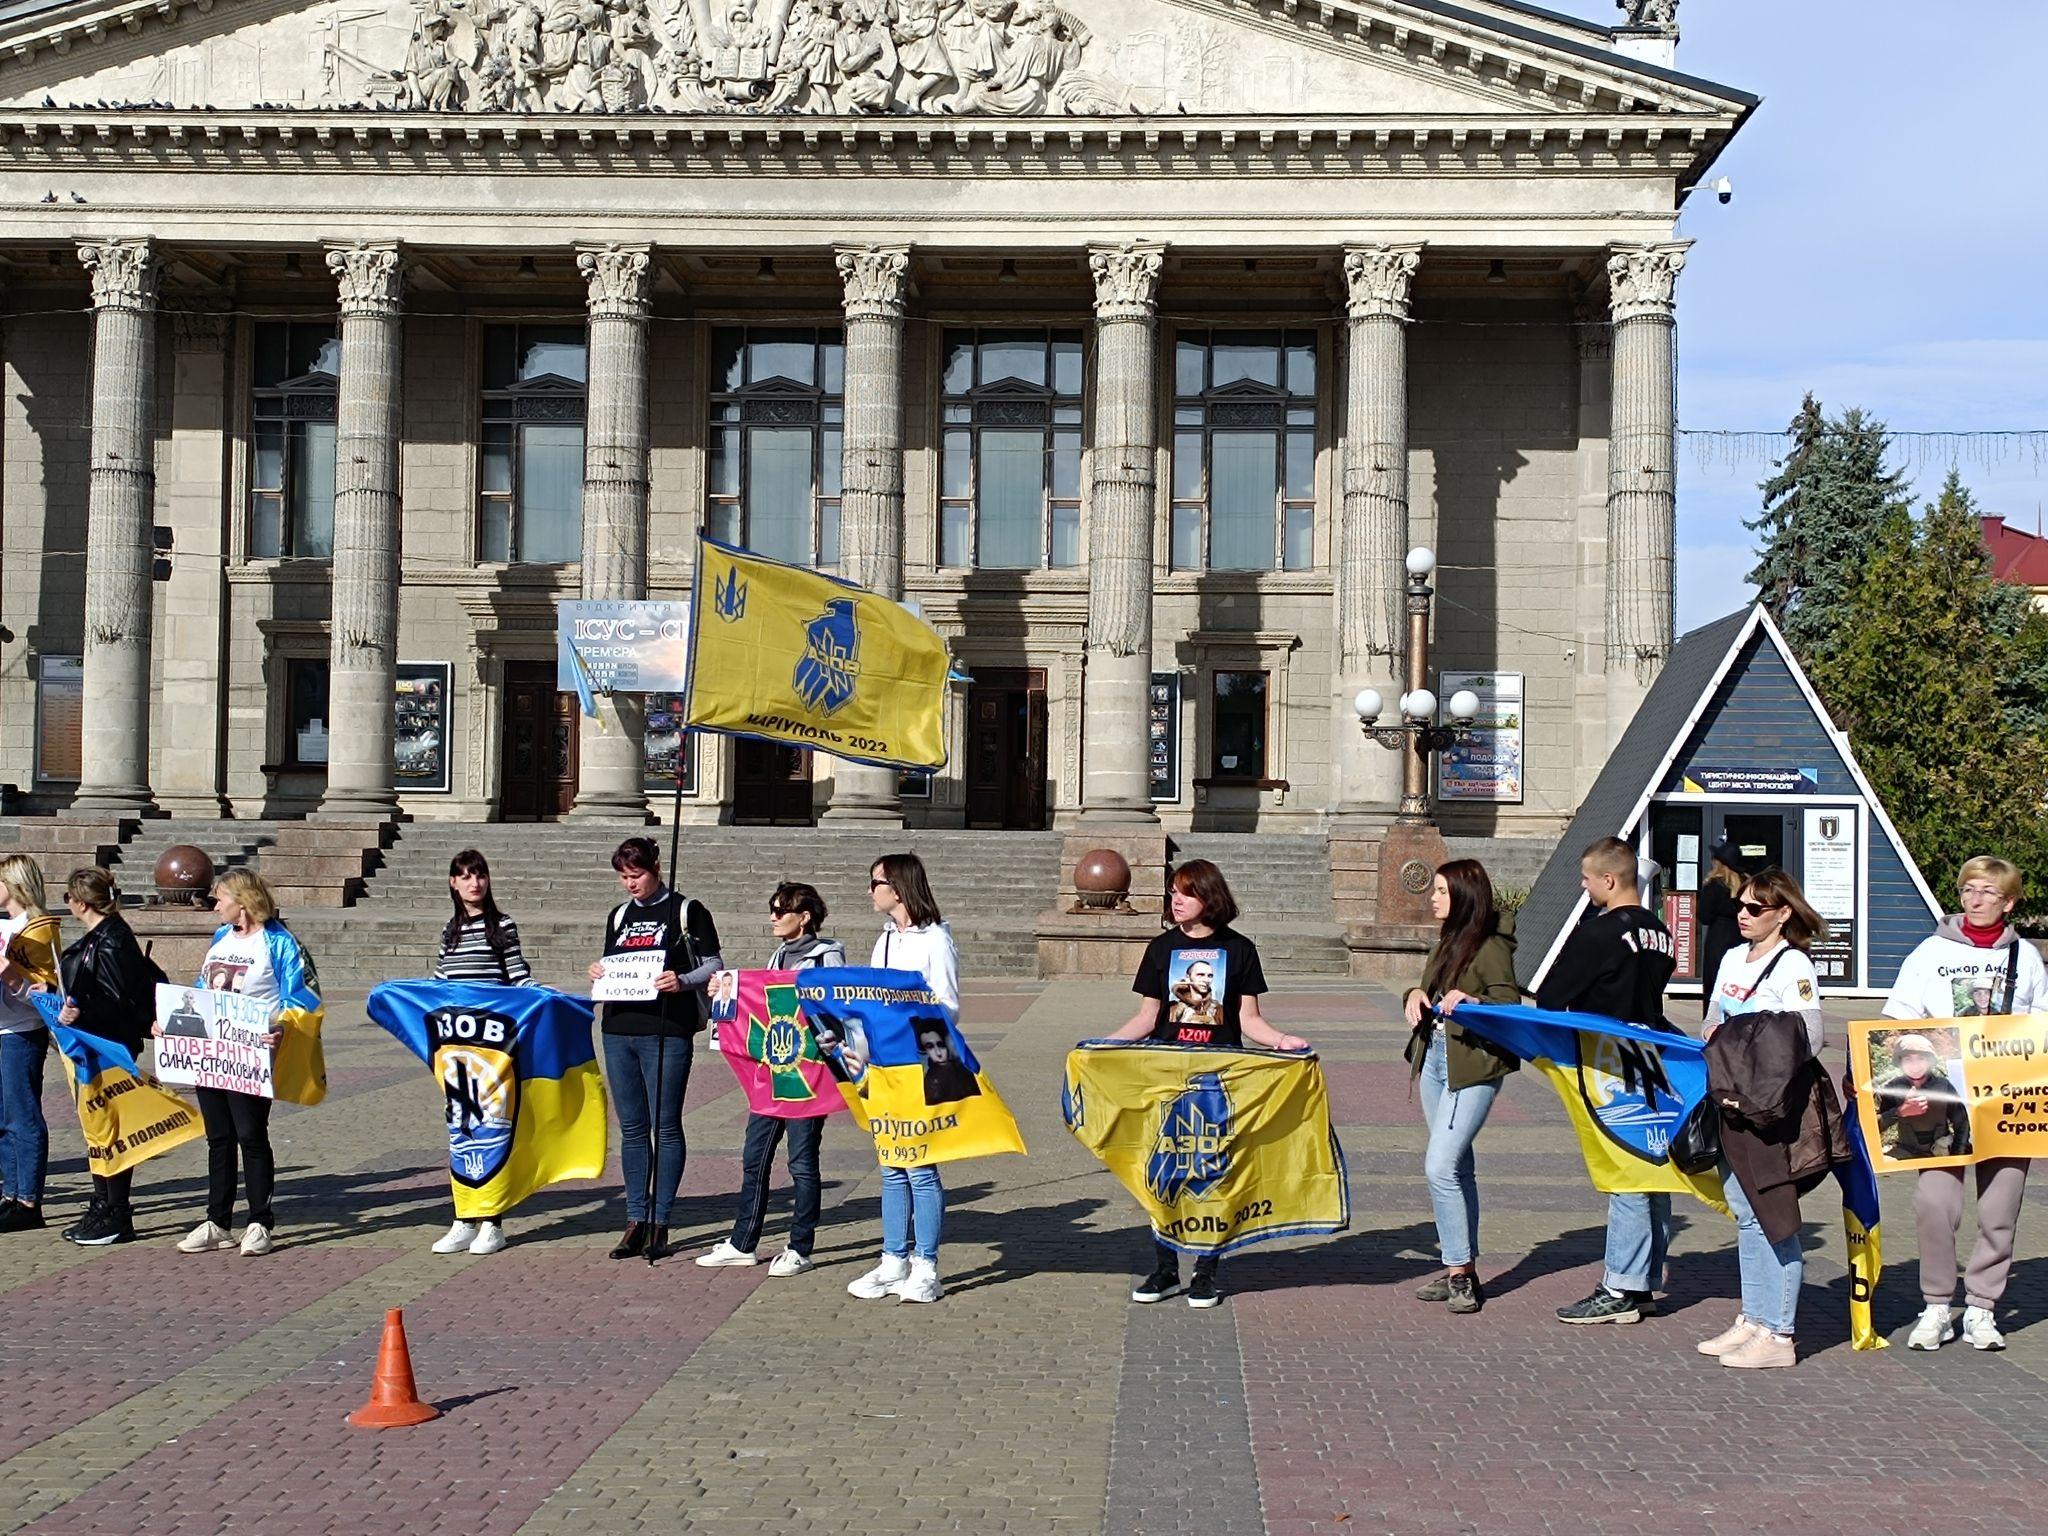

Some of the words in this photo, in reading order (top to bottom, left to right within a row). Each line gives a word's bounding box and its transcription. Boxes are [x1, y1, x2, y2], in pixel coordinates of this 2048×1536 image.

[575, 603, 672, 612] ВІДКРИТТЯ
[575, 619, 635, 641] ІСУС
[576, 646, 638, 658] ПРЕМ'ЄРА
[807, 646, 861, 676] АЗОВ
[744, 714, 843, 742] МАРІУПОЛЬ
[848, 735, 888, 753] 2022
[1708, 781, 1731, 789] ЦЕНТР
[1732, 781, 1752, 789] МІСТА
[1938, 965, 1979, 976] Січкар
[213, 993, 239, 1021] НГУ
[215, 1018, 232, 1042] 12
[1178, 1028, 1212, 1043] AZOV
[163, 1037, 262, 1071] ПОВЕРНІТЬ
[1969, 1034, 2035, 1061] Січкар
[1973, 1086, 1993, 1098] 12
[2003, 1102, 2036, 1117] В/Ч
[1997, 1121, 2048, 1135] Строк
[894, 1144, 928, 1162] 9937
[1234, 1200, 1273, 1226] 2022
